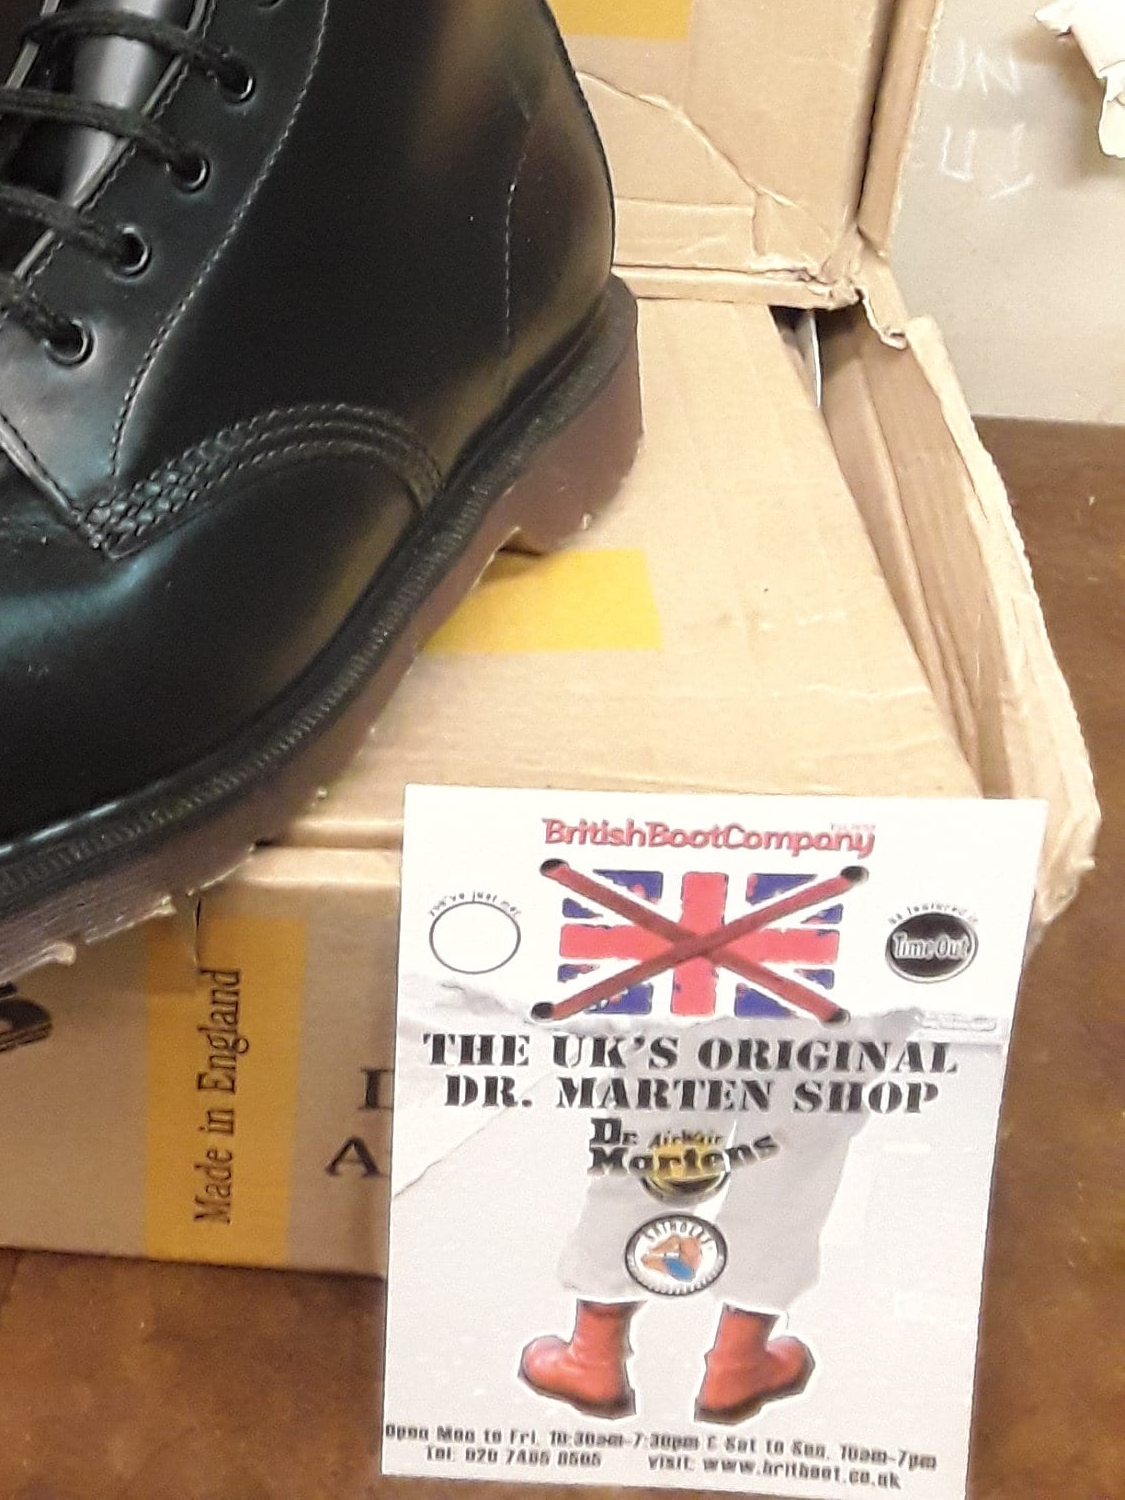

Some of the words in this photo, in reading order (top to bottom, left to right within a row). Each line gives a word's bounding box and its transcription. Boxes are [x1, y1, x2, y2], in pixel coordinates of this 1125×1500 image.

[196, 967, 250, 1094] England
[423, 1033, 531, 1067] THE
[552, 1034, 679, 1070] UK'S
[697, 1037, 958, 1074] ORIGINAL
[444, 1074, 533, 1108] DR.
[555, 1076, 773, 1113] MARTEN
[793, 1081, 941, 1115] SHOP
[198, 1107, 236, 1136] in
[587, 1135, 779, 1175] Martens
[194, 1146, 233, 1225] Made
